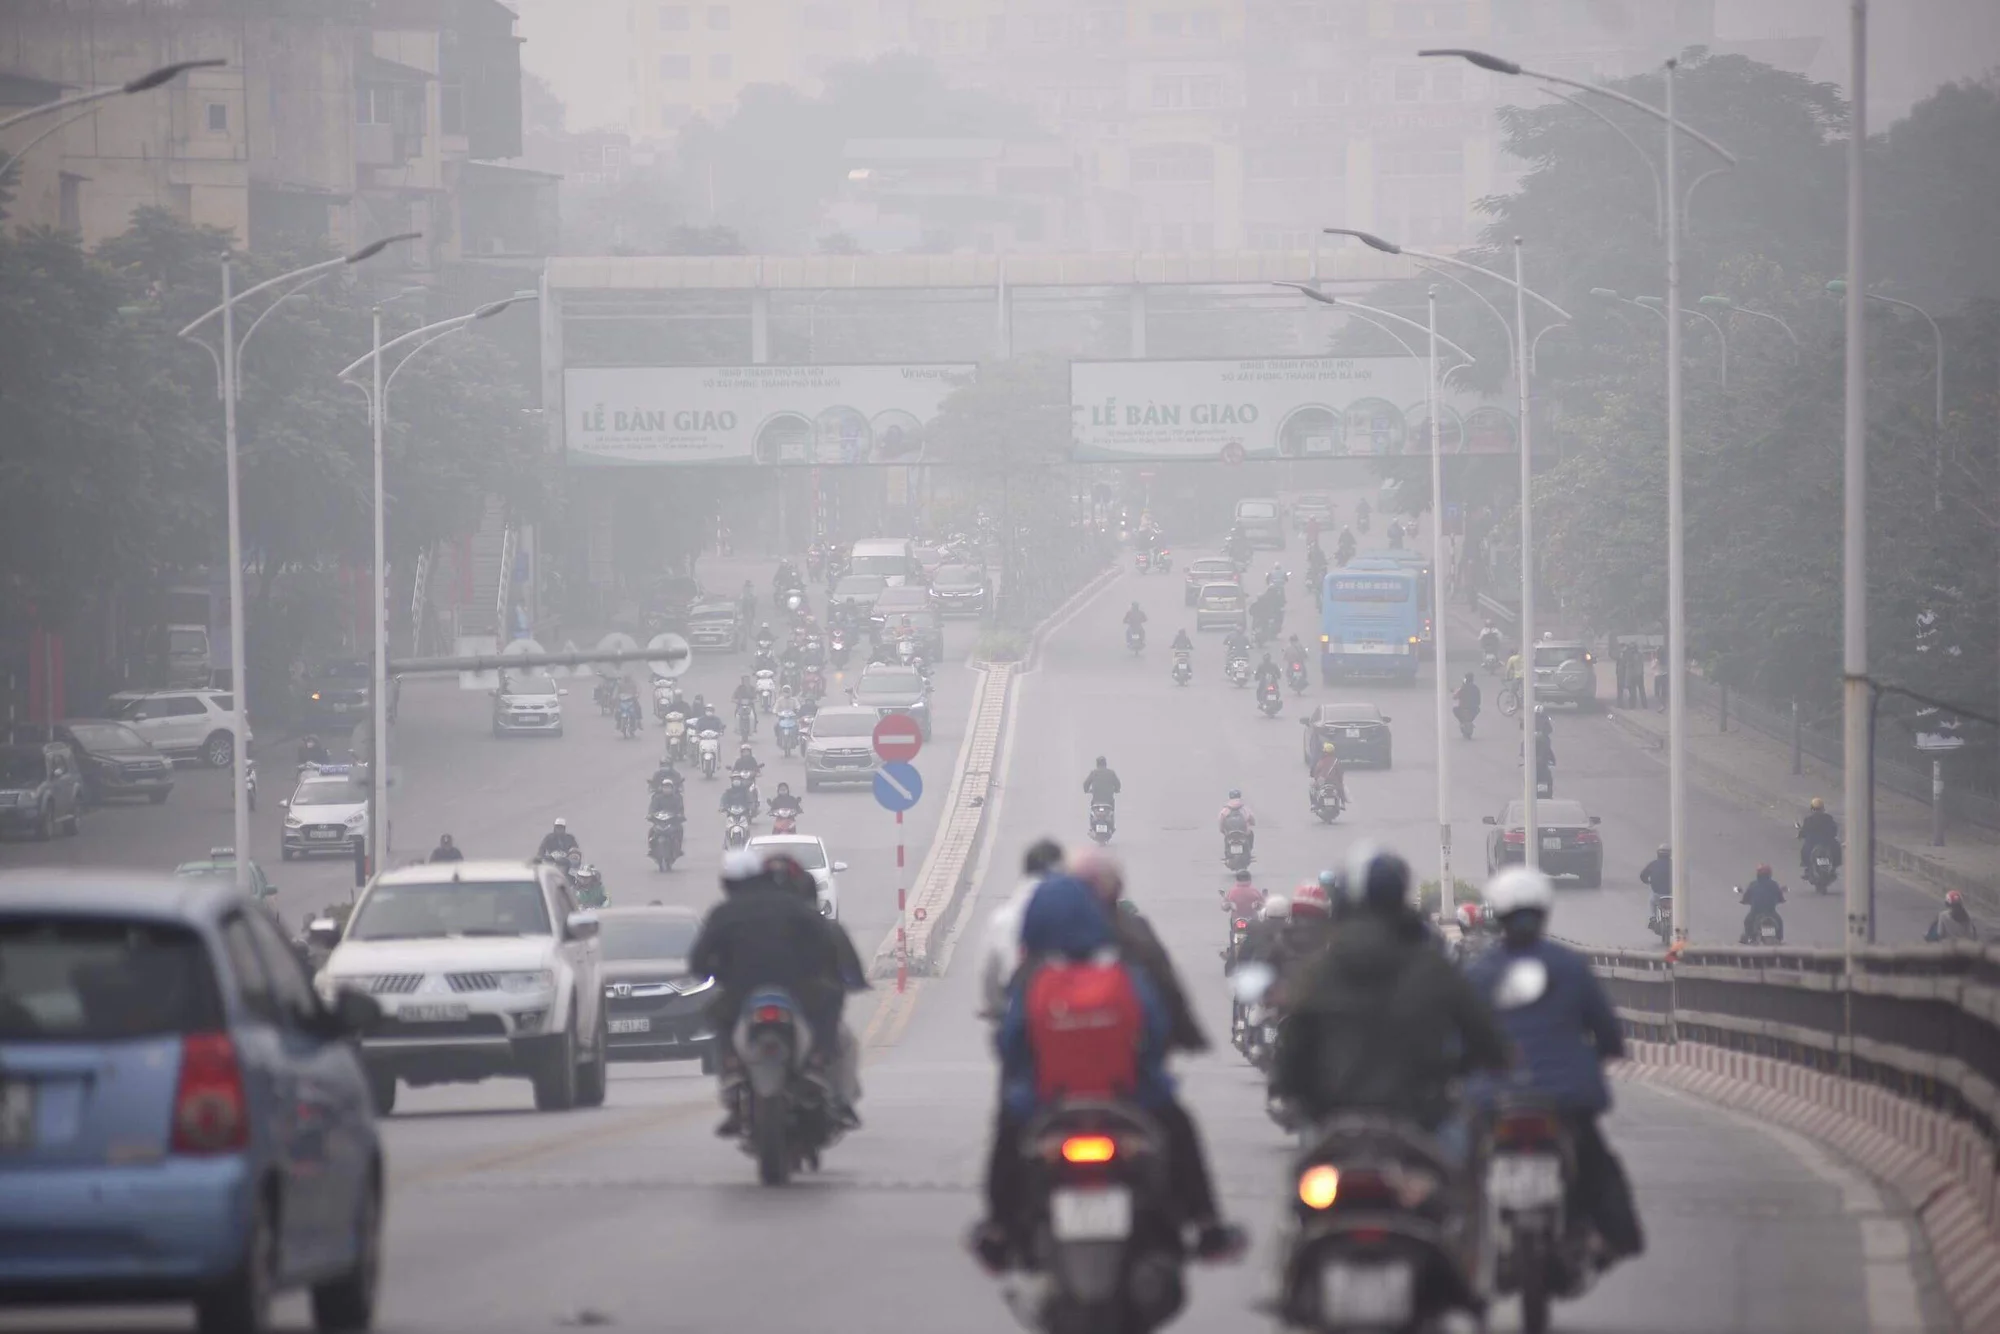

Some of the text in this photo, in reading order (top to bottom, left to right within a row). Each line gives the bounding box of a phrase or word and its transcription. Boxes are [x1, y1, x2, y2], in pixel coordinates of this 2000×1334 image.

[581, 403, 738, 432] LỄ BÀN GIAO
[1091, 396, 1259, 426] LỄ BÀN GIAO
